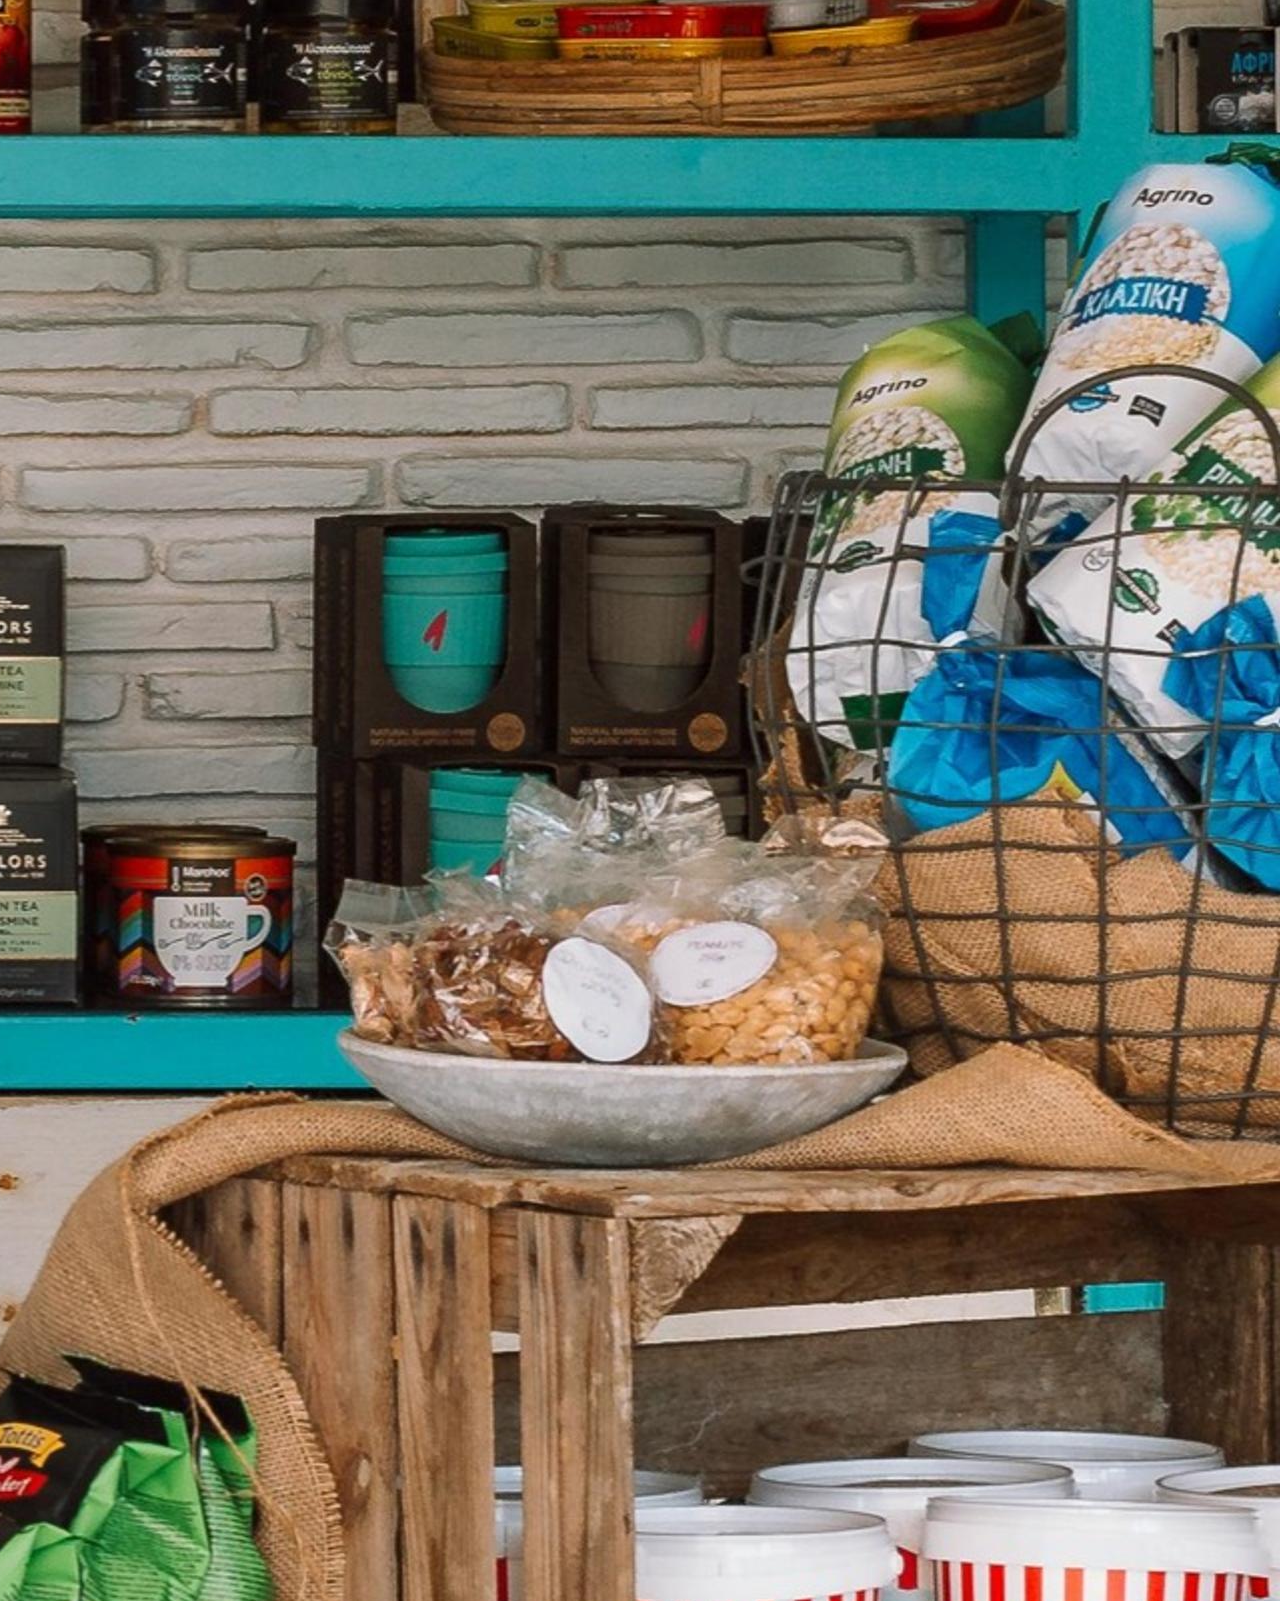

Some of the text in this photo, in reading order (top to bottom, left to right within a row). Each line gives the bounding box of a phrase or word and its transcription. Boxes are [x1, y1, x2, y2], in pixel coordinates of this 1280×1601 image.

[1133, 185, 1215, 210] Agrino
[1078, 280, 1189, 322] ΚΛΑΣΙΚΗ
[848, 375, 928, 409] Agrino
[12, 900, 40, 912] TEA
[183, 902, 222, 918] Milk
